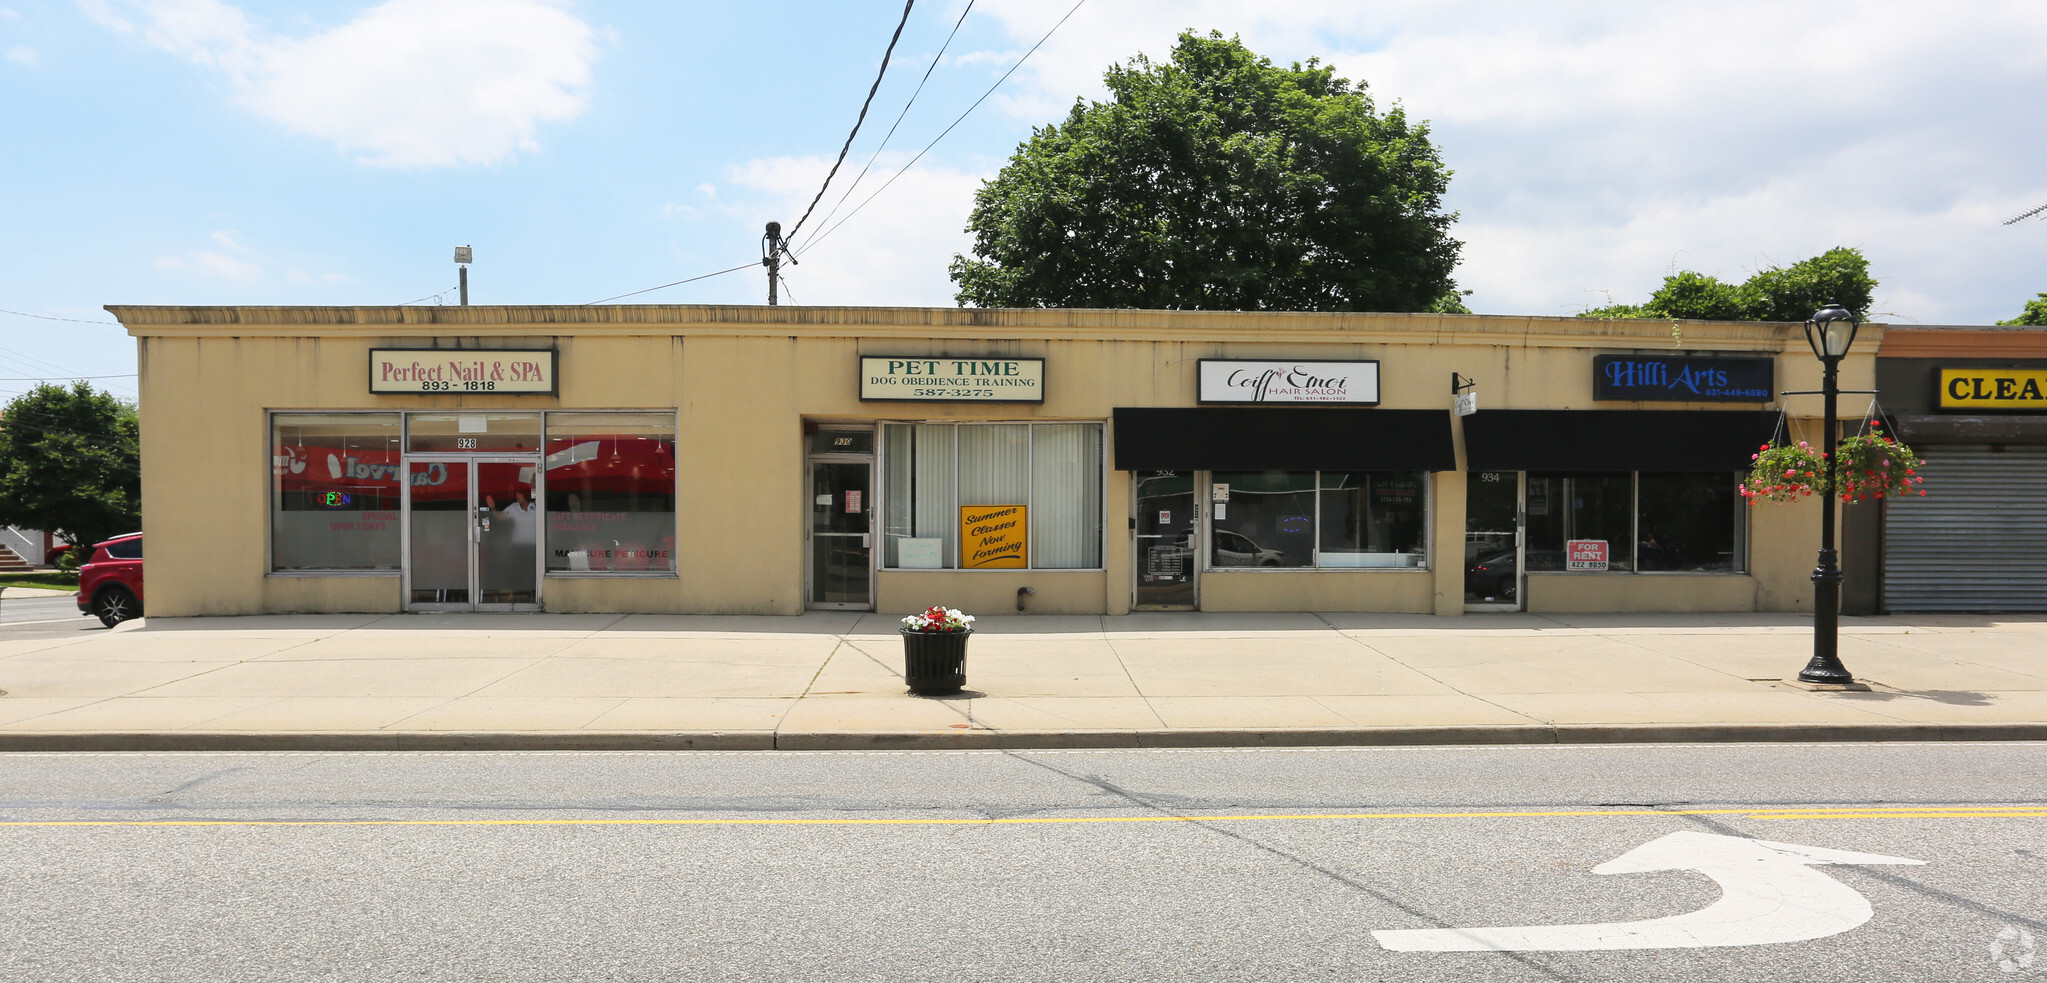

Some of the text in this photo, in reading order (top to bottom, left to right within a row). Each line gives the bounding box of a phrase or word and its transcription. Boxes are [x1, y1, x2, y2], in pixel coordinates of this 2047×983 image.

[381, 361, 544, 382] Perfect Nail & SPA
[888, 360, 1020, 376] PET TIME
[870, 376, 1035, 388] DOG OBEDIENCE TRAINING
[1286, 365, 1347, 389] Emoi
[1605, 361, 1728, 394] Hilli Arts
[422, 381, 449, 391] 893
[463, 381, 495, 391] 1818
[1305, 388, 1347, 396] SALON
[1948, 377, 2047, 400] CLEA
[913, 388, 994, 398] 587-3275
[458, 438, 476, 448] 928
[1481, 472, 1500, 482] 934
[317, 492, 351, 505] OPEN
[361, 512, 398, 521] SPECIAL
[552, 512, 627, 522] GIFT CERTIFICATE
[965, 507, 1017, 525] Summer
[329, 521, 354, 531] OPEN
[362, 521, 386, 531] DAYS
[971, 520, 1016, 537] Classes
[979, 534, 1006, 548] Now
[1577, 543, 1599, 551] FOR
[972, 541, 1022, 560] Forming
[1573, 551, 1602, 560] RENT
